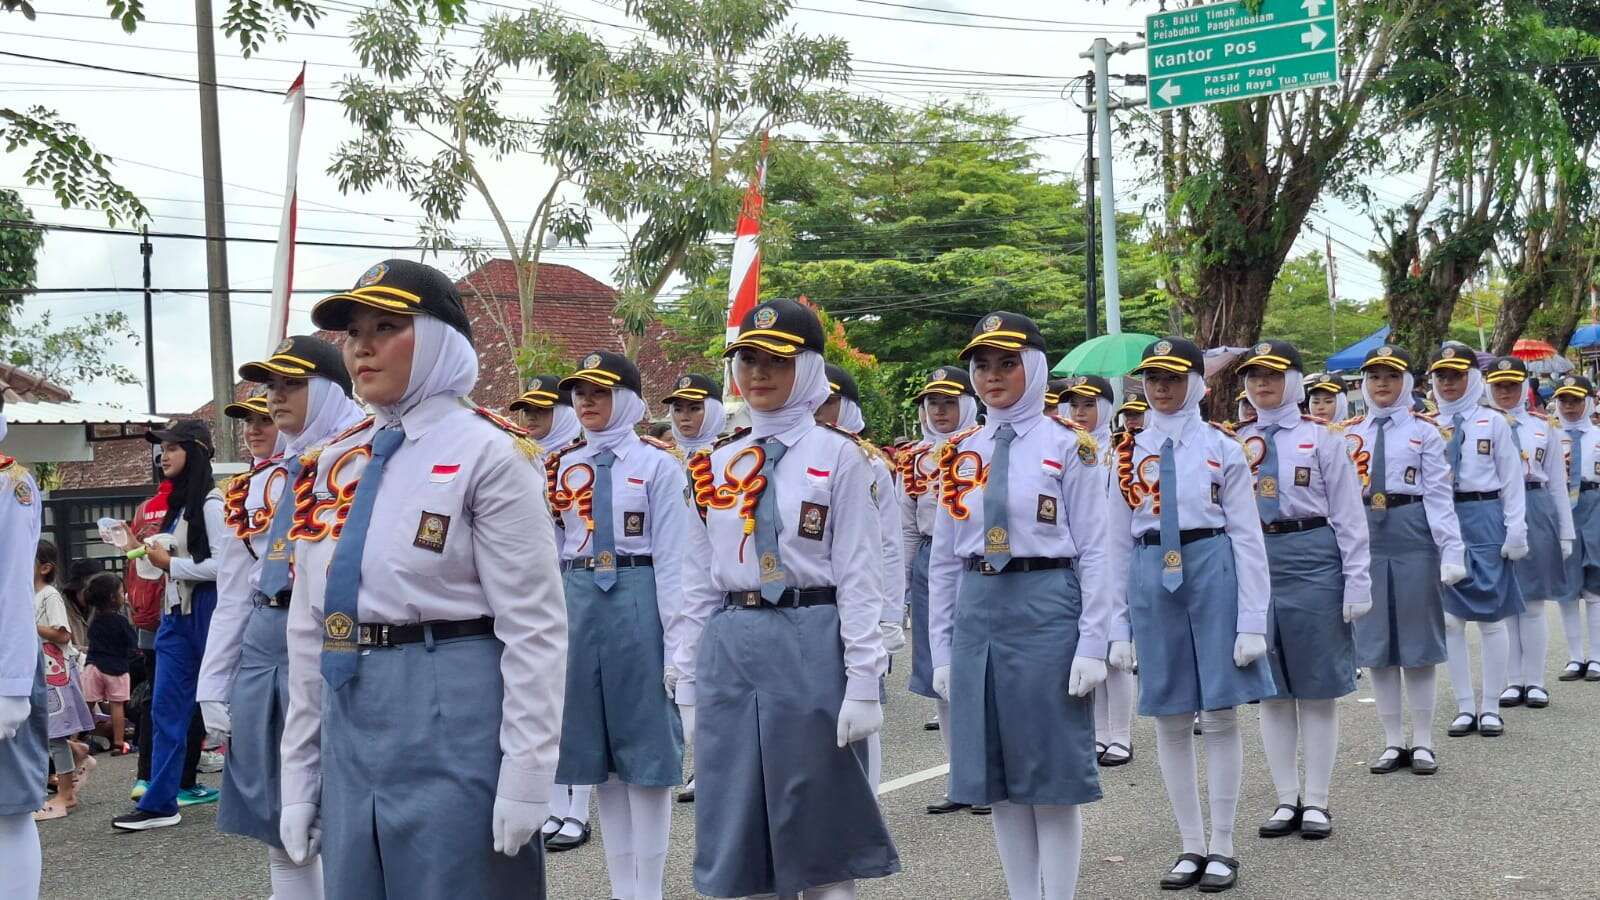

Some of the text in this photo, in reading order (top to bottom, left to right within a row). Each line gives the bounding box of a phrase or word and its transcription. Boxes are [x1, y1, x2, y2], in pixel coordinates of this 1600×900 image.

[1153, 8, 1236, 29] RS. Bakti Timah
[1153, 13, 1274, 40] Pelabuhan Pangkalbalam
[1154, 41, 1257, 68] Kantor Pos
[1204, 64, 1276, 84] Pasar Pagi
[1205, 71, 1329, 96] Mesjid Raya Tua Tunu
